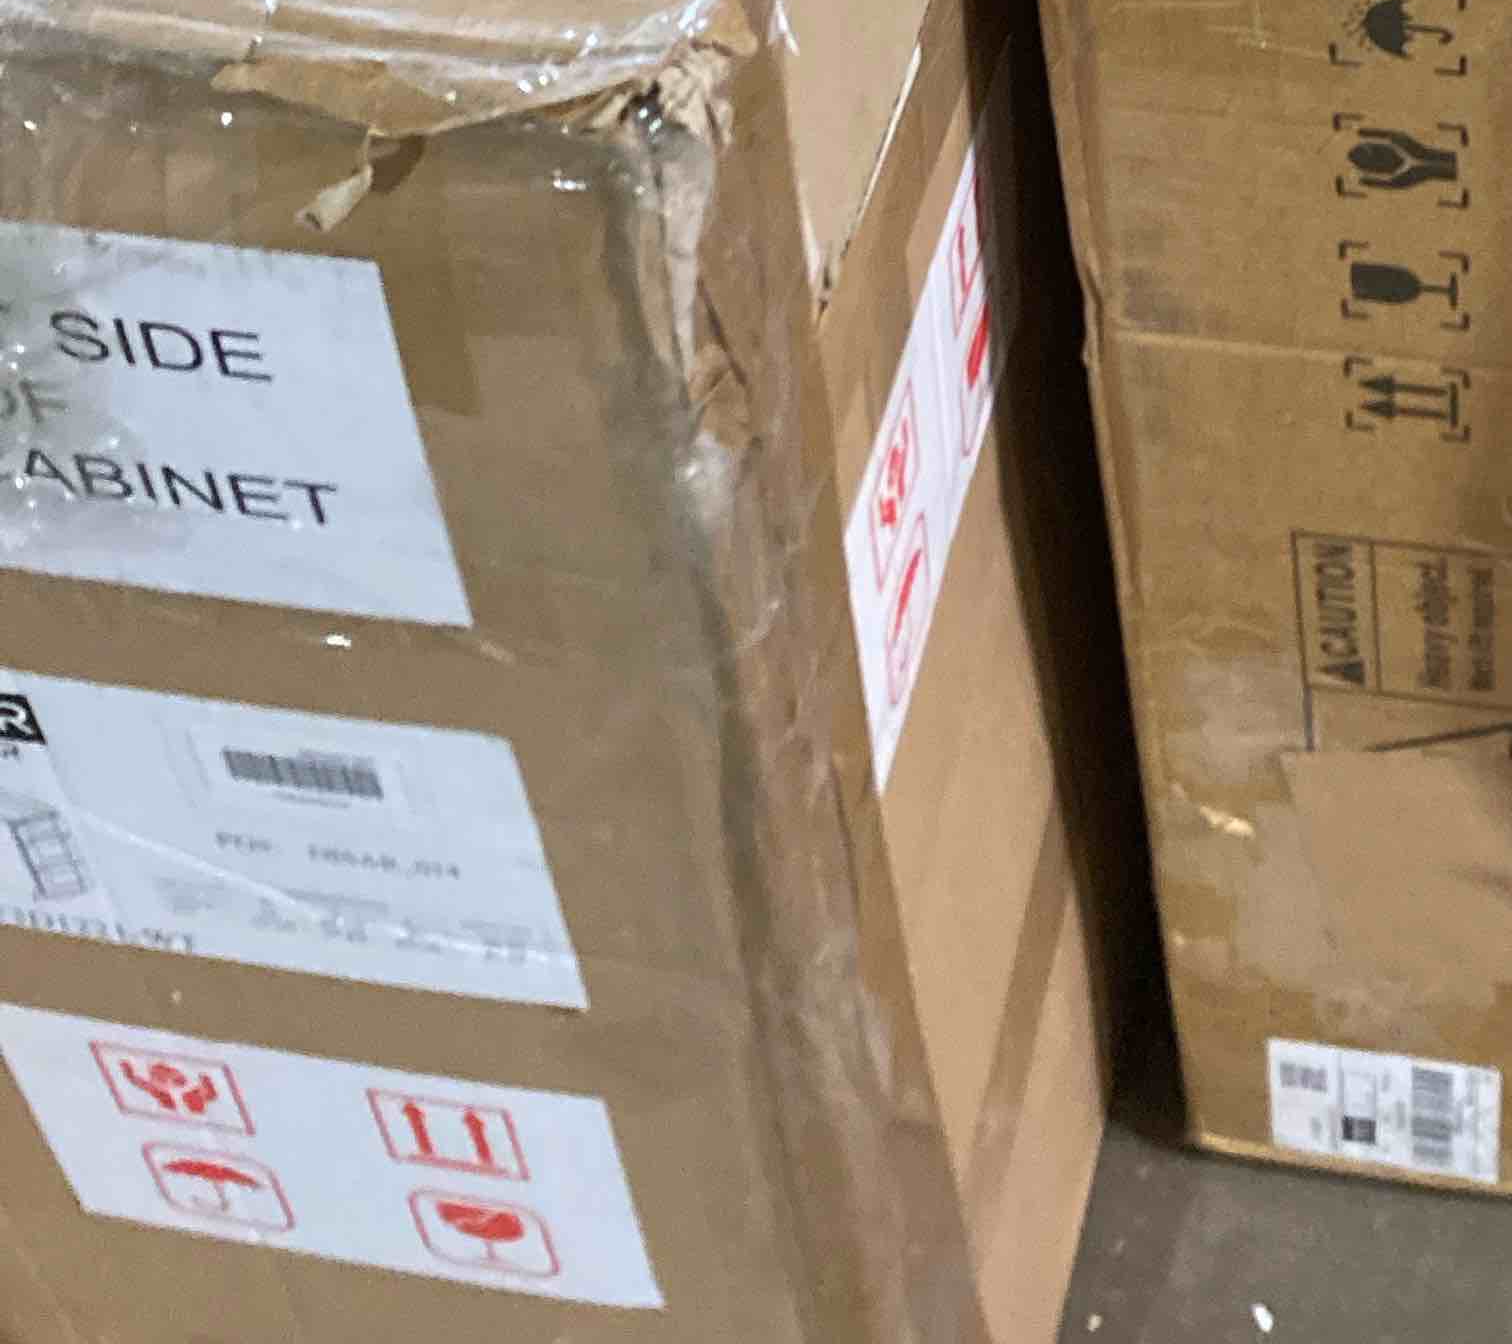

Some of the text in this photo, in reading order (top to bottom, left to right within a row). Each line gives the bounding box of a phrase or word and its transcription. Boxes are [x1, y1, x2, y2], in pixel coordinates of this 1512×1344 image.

[49, 309, 273, 383] SIDE
[0, 377, 68, 424] F
[0, 448, 338, 525] ABINET
[1314, 543, 1358, 656] CAUTION
